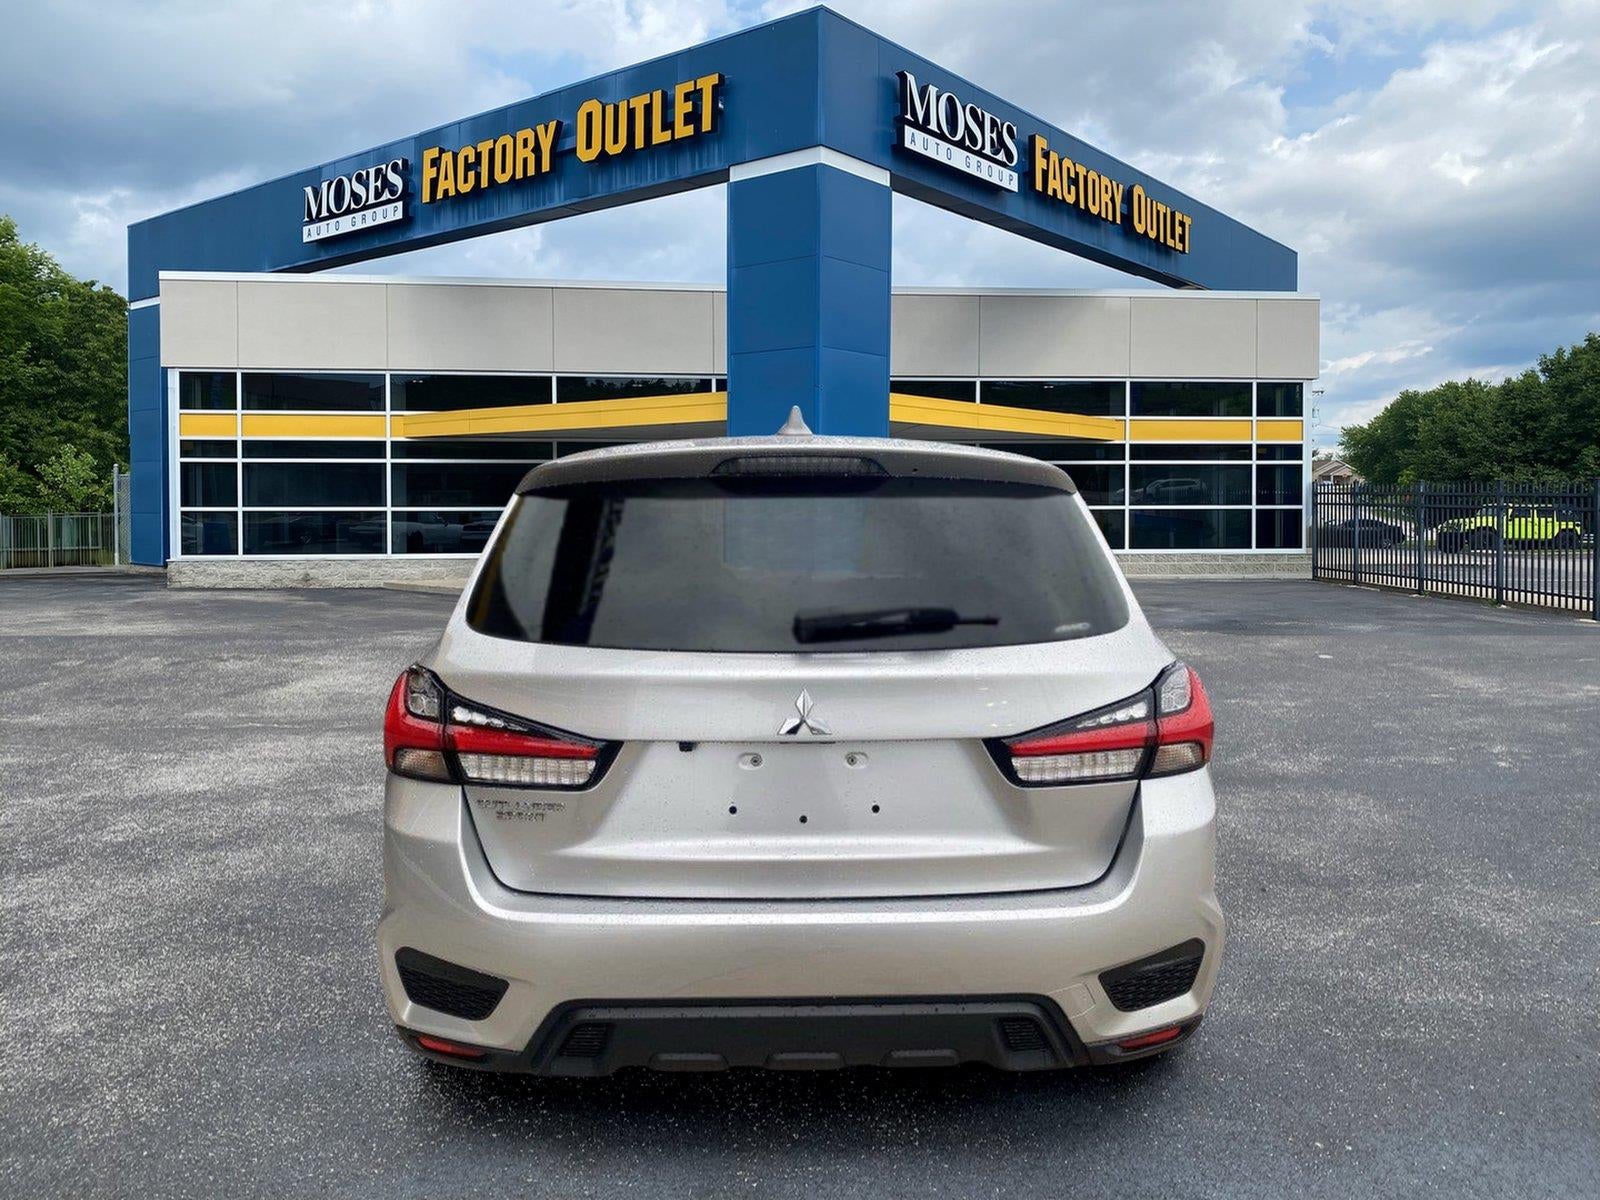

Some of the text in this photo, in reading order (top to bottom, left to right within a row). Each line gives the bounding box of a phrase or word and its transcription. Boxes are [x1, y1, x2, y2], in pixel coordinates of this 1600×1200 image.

[421, 72, 721, 204] FACTORY OUTLET
[903, 70, 1019, 167] MOSES
[909, 131, 1014, 186] AUTO GROUP
[302, 158, 404, 222] MOSES
[307, 205, 399, 239] AUTO GROUP
[1034, 134, 1192, 254] FACTORY OUTLET
